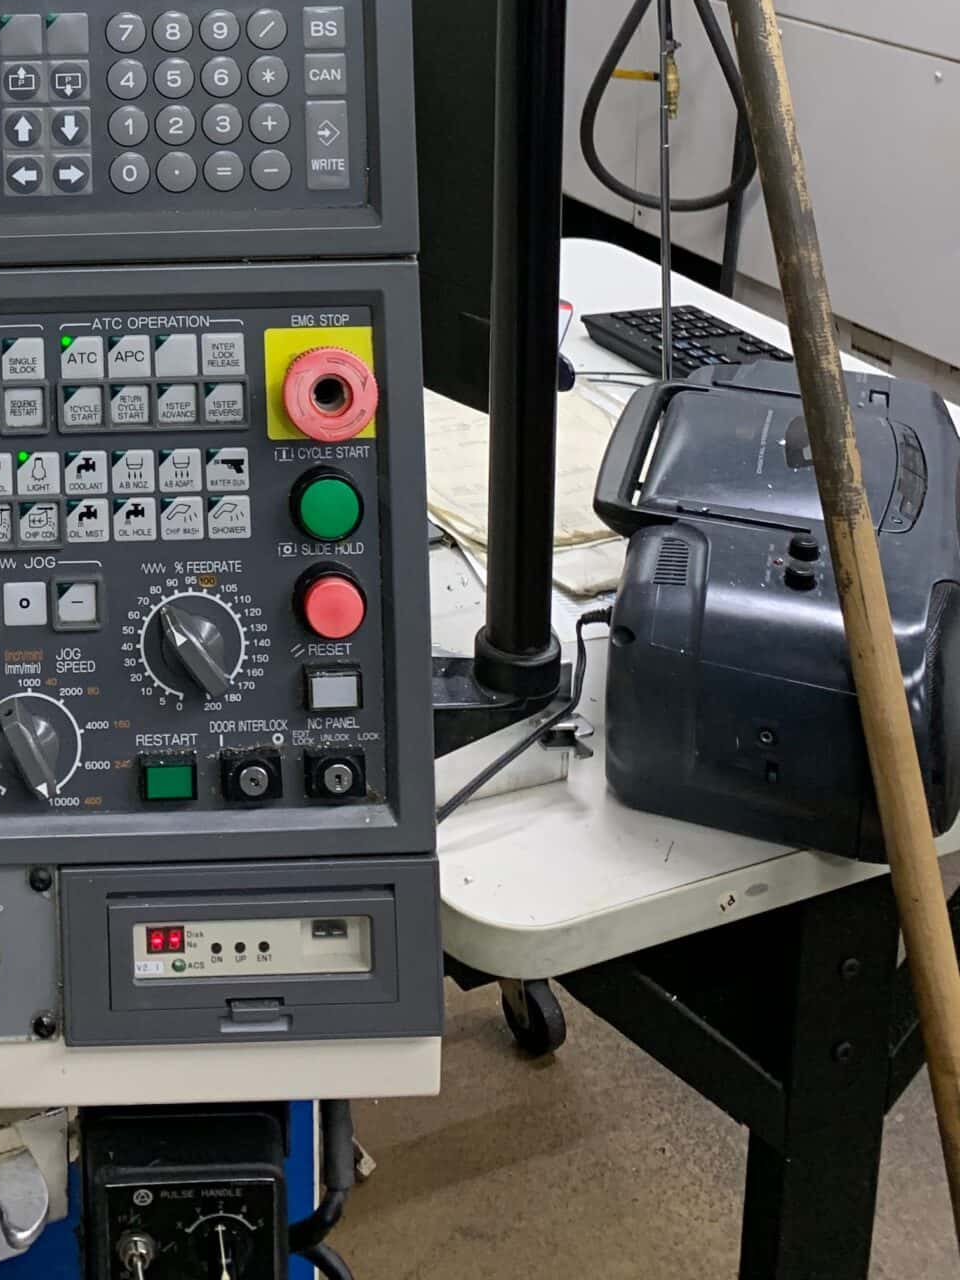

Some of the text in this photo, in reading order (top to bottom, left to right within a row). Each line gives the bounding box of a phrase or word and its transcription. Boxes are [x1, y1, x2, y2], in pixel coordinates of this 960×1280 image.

[310, 21, 338, 37] BS
[309, 69, 341, 81] CAN
[311, 158, 345, 171] WRITE
[91, 315, 210, 331] ATC OPERATION
[291, 313, 350, 327] EMG STOP
[67, 351, 98, 365] ATC
[114, 350, 145, 363] APC
[297, 445, 370, 460] CYCLE START
[26, 483, 50, 492] LIGHT
[68, 482, 103, 490] COOLANT
[301, 542, 365, 556] SLIDE HOLD
[23, 556, 56, 569] JOG
[186, 560, 242, 573] FEEDRATE
[55, 648, 82, 660] JOG
[308, 643, 352, 656] RESET
[55, 660, 96, 673] SPEED
[209, 719, 289, 733] DOOR INTERLOCK
[307, 716, 360, 729] NC PANEL
[135, 733, 199, 747] RESTART
[160, 1187, 243, 1200] PULSE HANDLE
